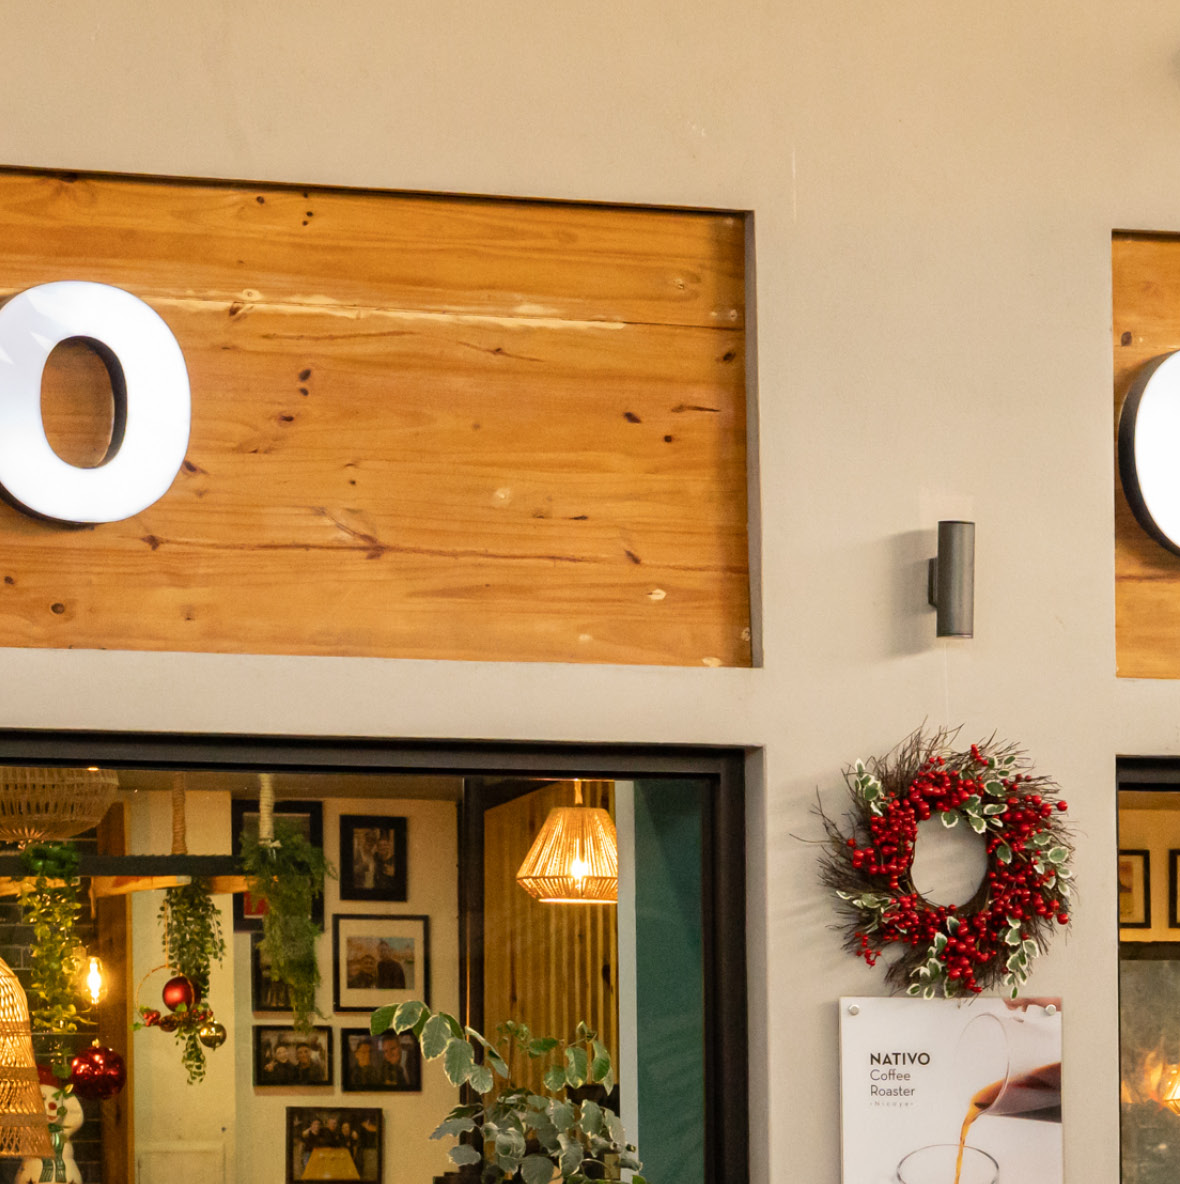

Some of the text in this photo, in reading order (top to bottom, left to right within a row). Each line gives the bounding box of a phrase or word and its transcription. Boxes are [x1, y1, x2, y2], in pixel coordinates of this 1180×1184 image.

[0, 280, 191, 524] O
[870, 1052, 931, 1066] NATIVO
[870, 1068, 911, 1081] Coffee
[870, 1084, 916, 1097] Roaster
